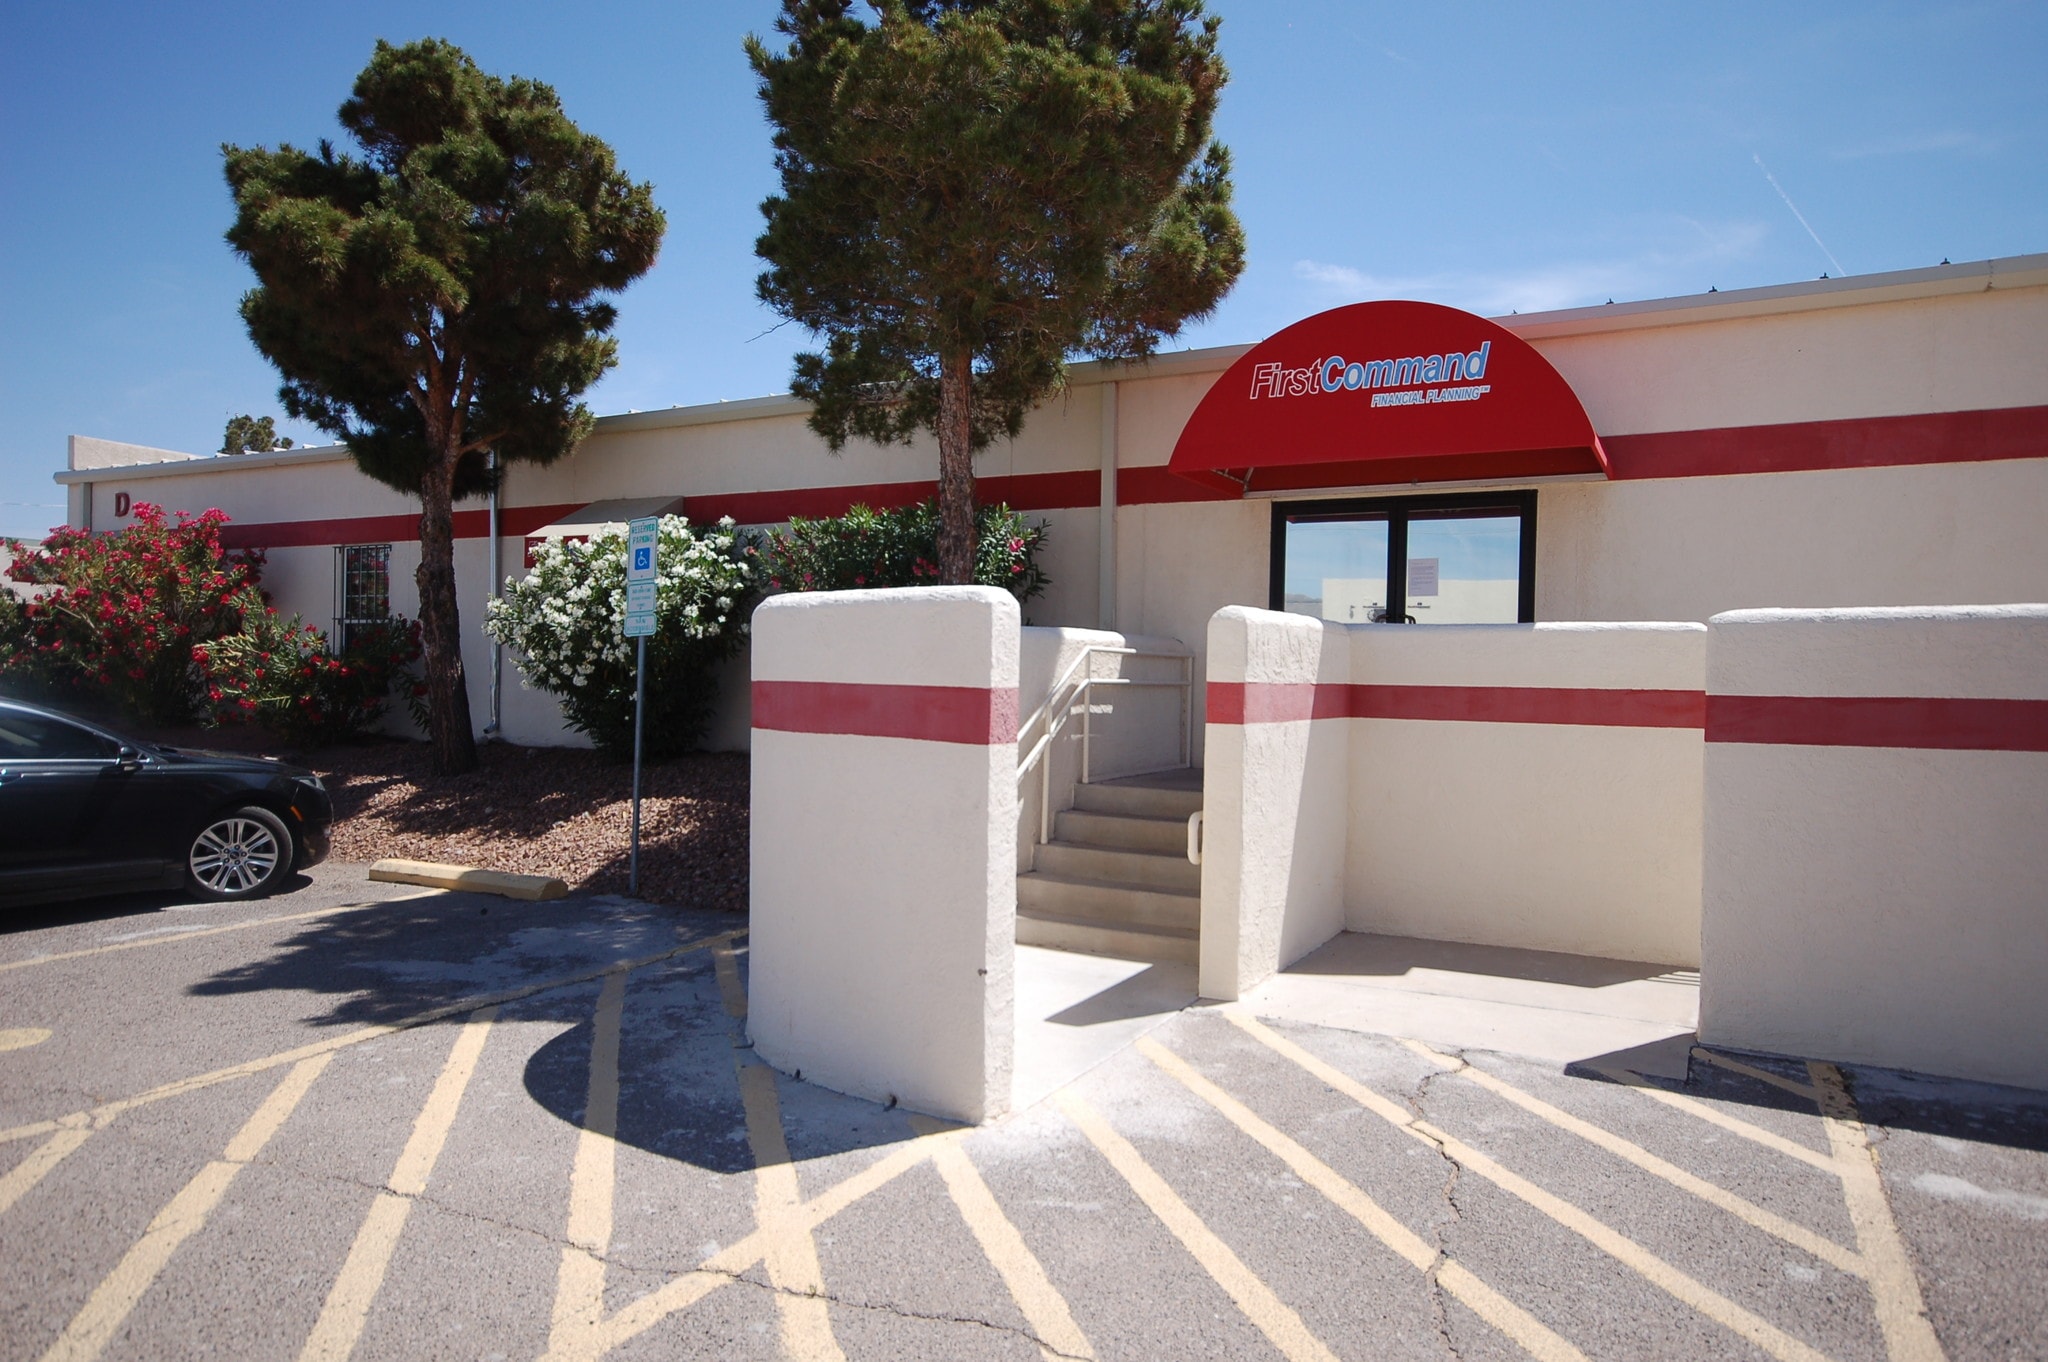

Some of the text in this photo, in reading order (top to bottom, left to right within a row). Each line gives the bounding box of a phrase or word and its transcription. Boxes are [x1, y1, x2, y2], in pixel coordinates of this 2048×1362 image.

[1371, 390, 1425, 408] FINANCIAL
[115, 492, 130, 518] D
[631, 523, 655, 534] RESERVED
